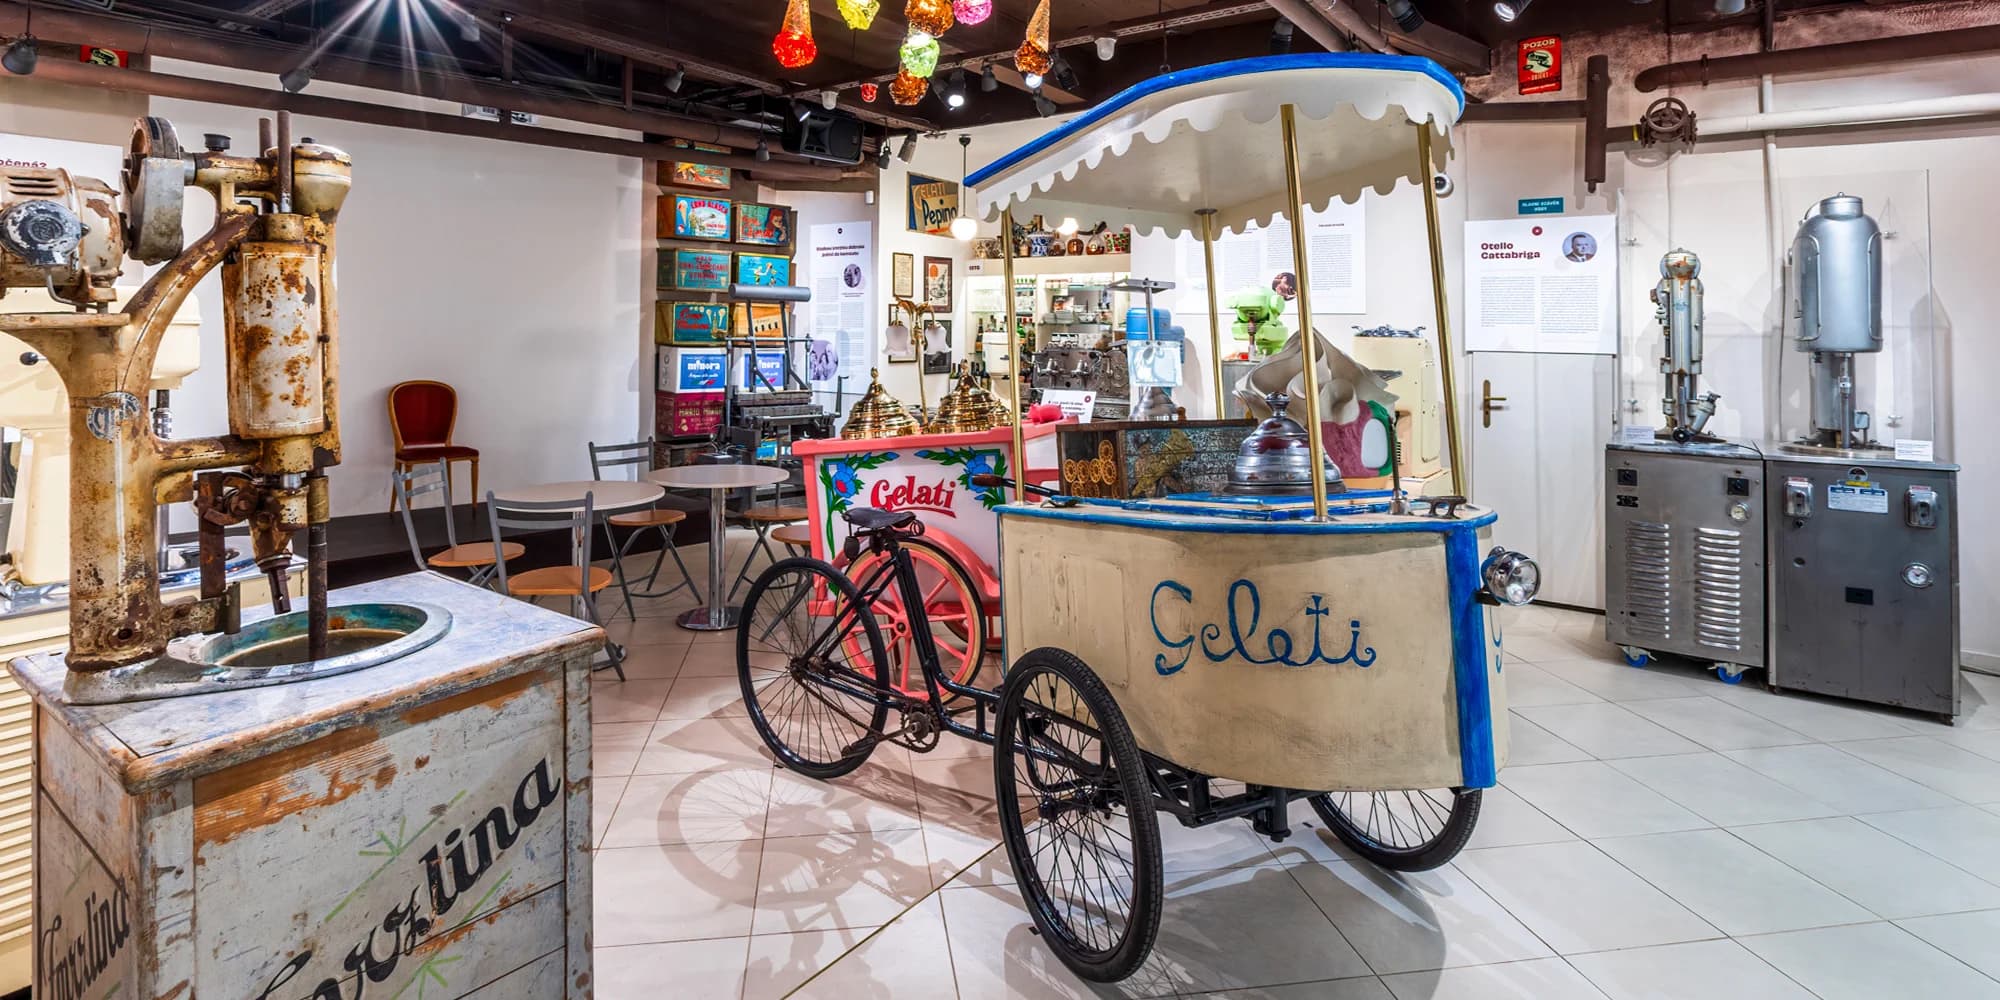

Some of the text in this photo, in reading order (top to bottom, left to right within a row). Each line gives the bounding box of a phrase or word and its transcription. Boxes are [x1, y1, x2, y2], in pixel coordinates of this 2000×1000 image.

[1523, 39, 1556, 49] POZOR
[921, 199, 957, 229] Pepino
[1480, 242, 1514, 250] Otello
[1480, 250, 1541, 260] Cattabriga
[870, 475, 956, 512] Gelati
[255, 756, 561, 1000] rzlina
